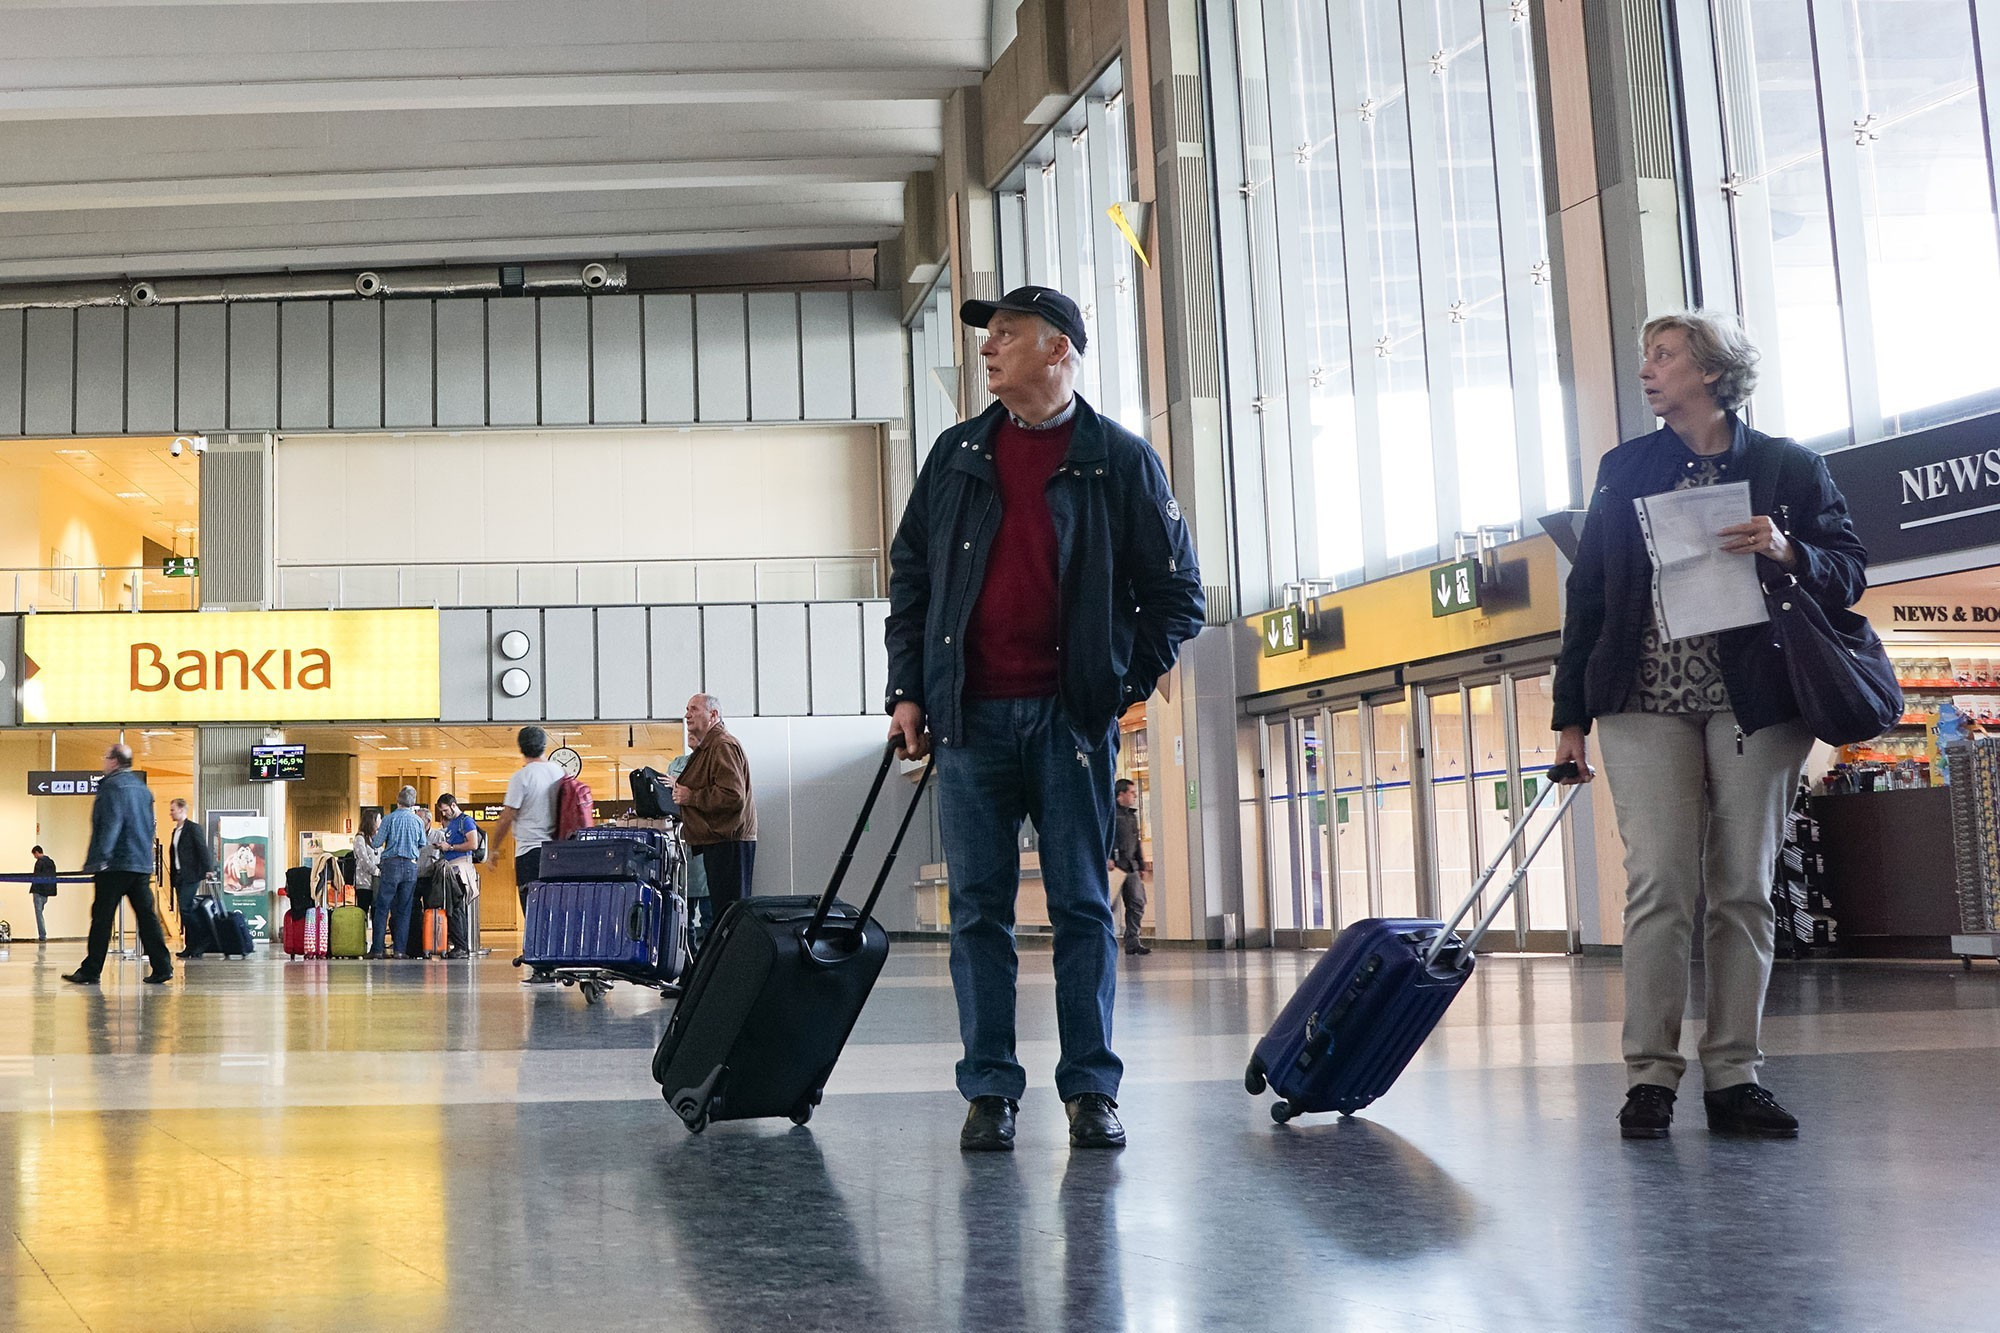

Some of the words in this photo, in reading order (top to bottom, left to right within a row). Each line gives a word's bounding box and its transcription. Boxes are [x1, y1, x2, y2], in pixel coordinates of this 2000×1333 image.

[1899, 448, 2000, 505] NEWS
[1893, 606, 1948, 622] NEWS
[1952, 606, 1967, 622] &
[1971, 606, 2000, 622] BO
[130, 642, 331, 692] Bankia
